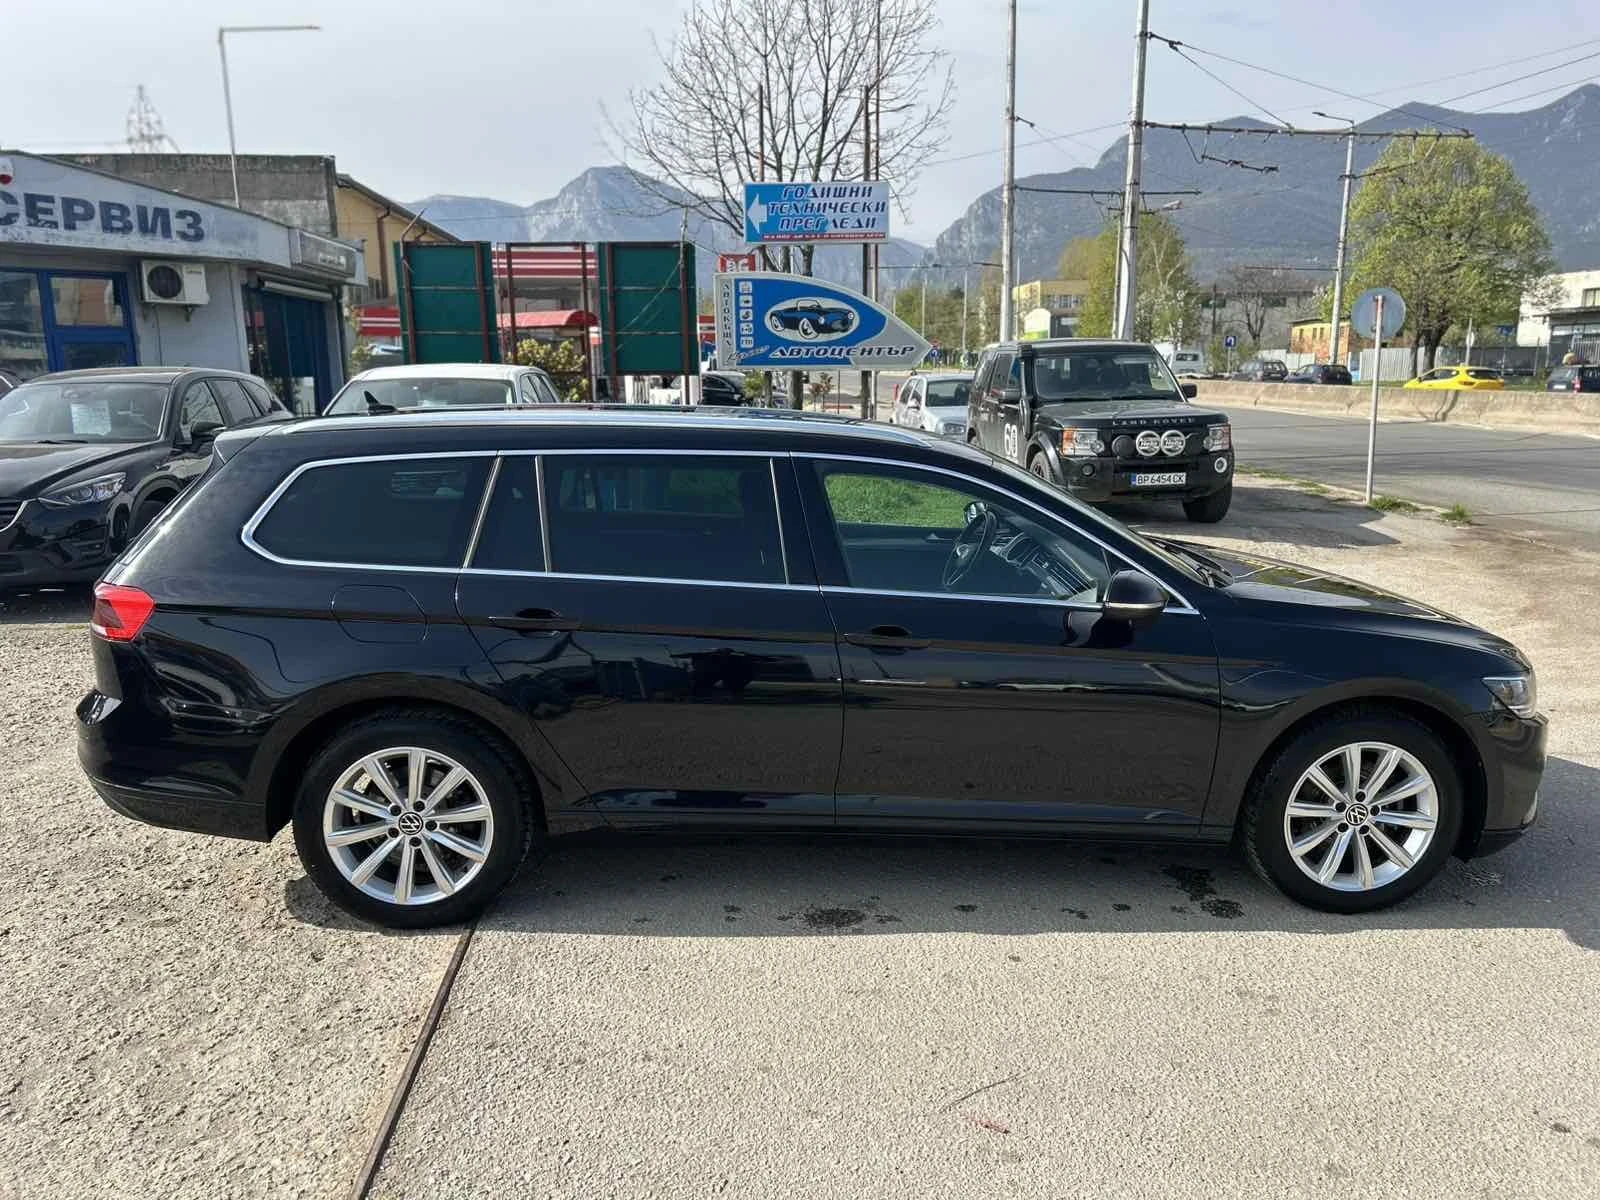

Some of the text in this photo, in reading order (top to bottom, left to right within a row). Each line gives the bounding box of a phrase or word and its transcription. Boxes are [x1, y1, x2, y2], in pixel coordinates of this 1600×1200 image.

[782, 186, 873, 199] ГОДИШНИ
[768, 201, 887, 215] ТЕХНИЧЕСКИ
[779, 217, 877, 231] ПРЕГЛЕДИ
[769, 345, 915, 359] АВТОЦЕНТЪР
